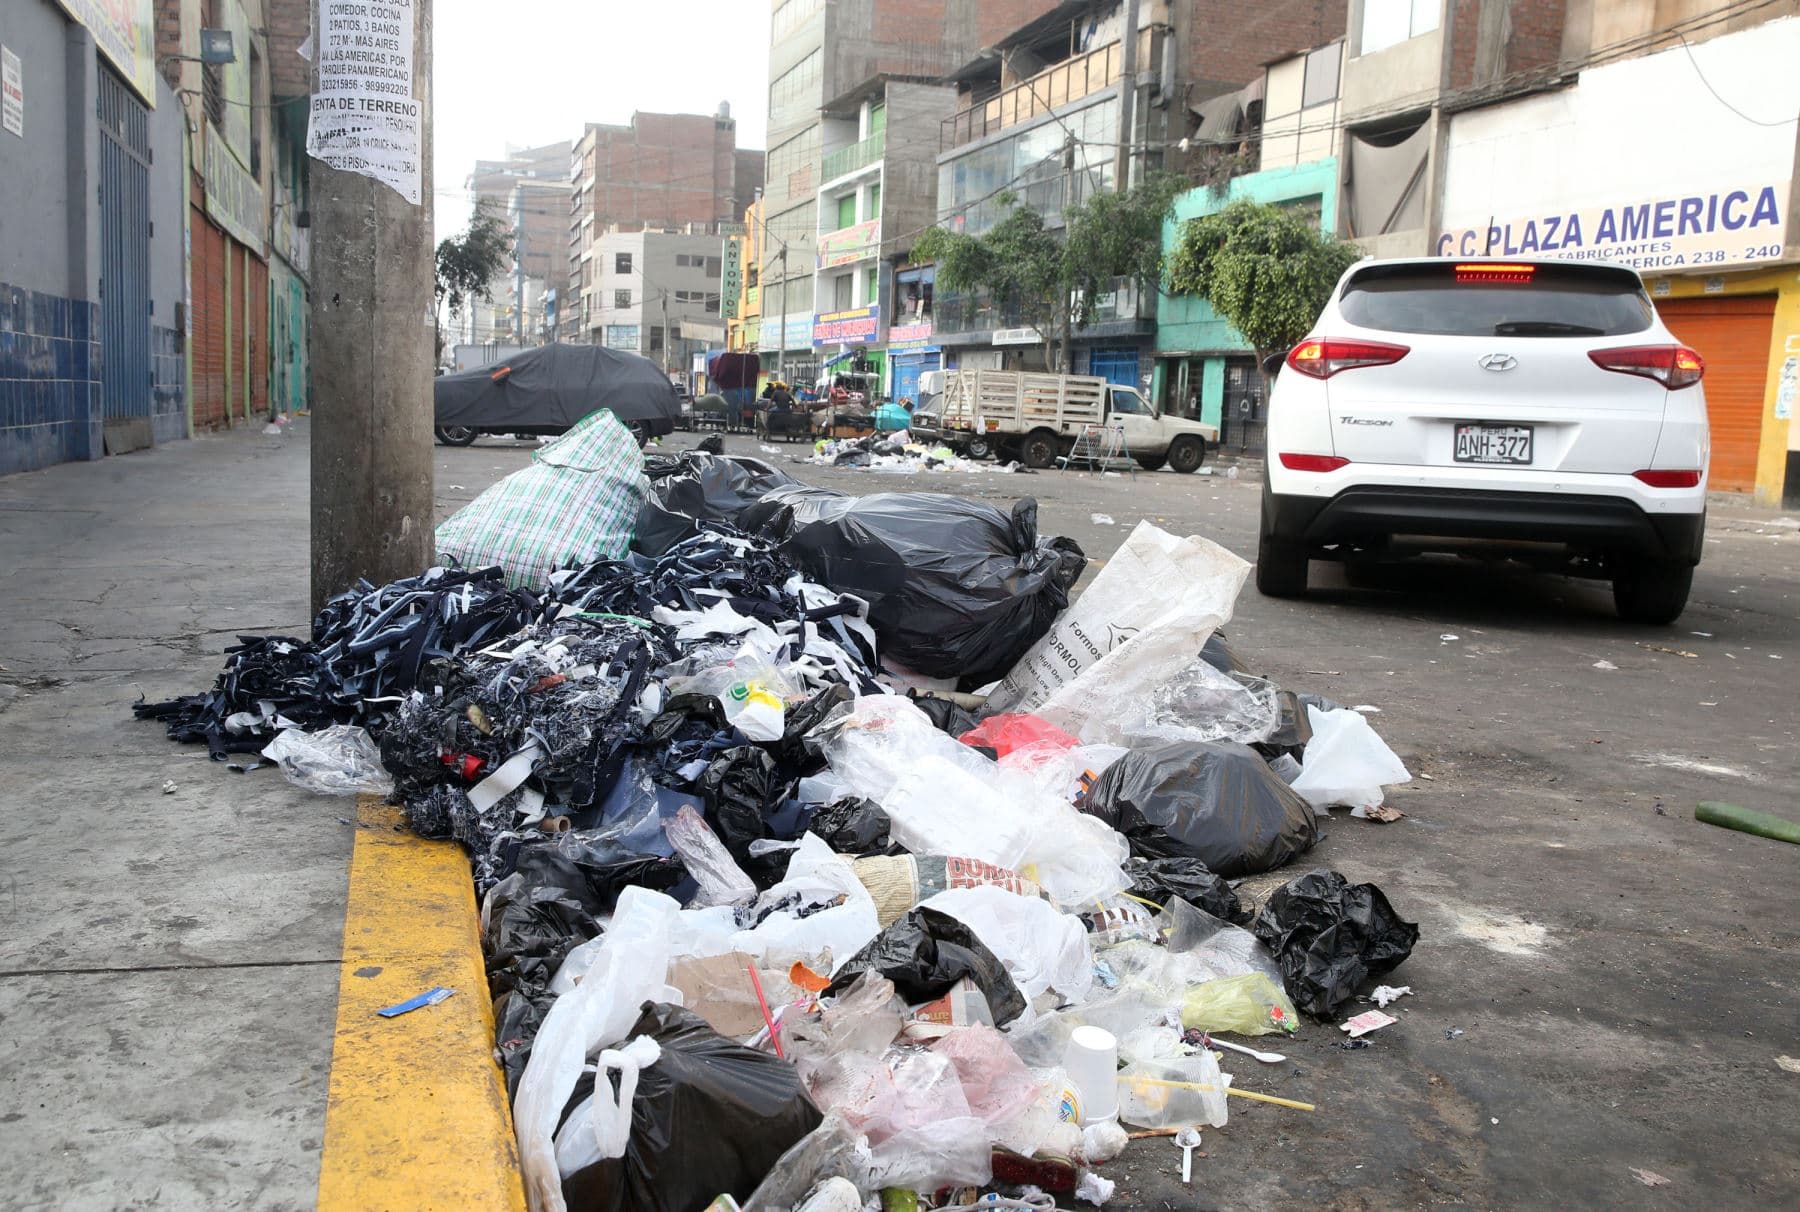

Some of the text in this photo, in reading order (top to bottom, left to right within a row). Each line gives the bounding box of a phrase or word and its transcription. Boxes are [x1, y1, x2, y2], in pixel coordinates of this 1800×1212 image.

[329, 4, 401, 21] COMEDOR, COCINA
[330, 35, 340, 46] 272
[355, 36, 373, 47] MAS
[375, 38, 399, 51] AIRES
[330, 50, 343, 61] LAS
[390, 55, 406, 67] POR
[321, 64, 408, 81] PARQUE PANAMERICANO
[339, 98, 355, 110] DE
[359, 98, 417, 117] TERRENO
[1486, 214, 1583, 256] PLAZA
[1594, 186, 1780, 245] AMERICA
[1618, 253, 1686, 269] MERICA
[1692, 249, 1726, 264] 238
[1744, 244, 1781, 260] 240
[1457, 434, 1529, 457] ANH-377
